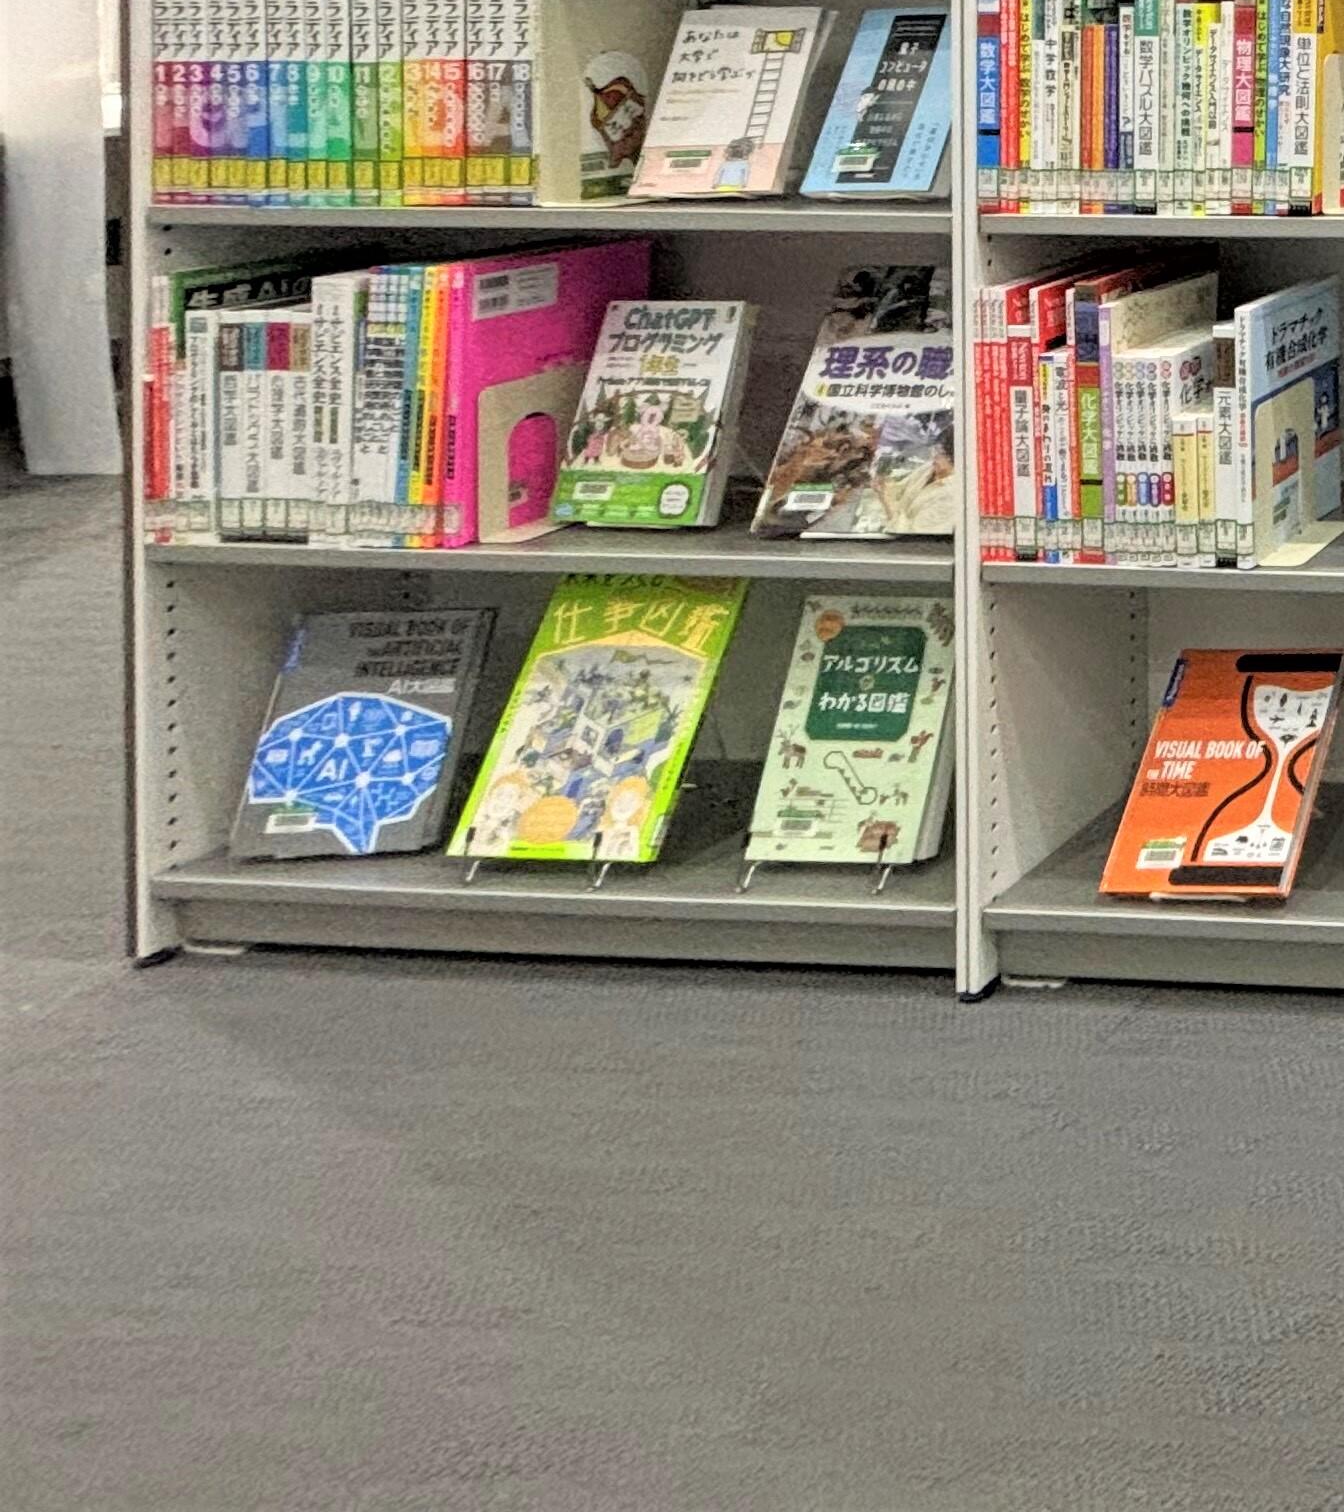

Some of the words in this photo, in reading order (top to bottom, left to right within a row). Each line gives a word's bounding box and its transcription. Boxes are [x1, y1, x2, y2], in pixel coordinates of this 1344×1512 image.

[684, 29, 740, 44] あなたは
[899, 42, 919, 55] 量子
[679, 49, 718, 63] 大学で
[879, 61, 927, 73] コンピュータ
[980, 43, 996, 125] 数学大図鑑
[1235, 40, 1253, 122] 物理大図鑑
[1139, 40, 1153, 155] 数学パズル大図鑑
[1295, 36, 1311, 155] 単位と法則大図鑑
[624, 307, 717, 331] ChatGPT
[1271, 308, 1324, 340] ドラマチック
[609, 332, 723, 355] プログラミング
[1264, 326, 1329, 371] 有機合成化学
[821, 346, 954, 380] 理系の職
[1014, 390, 1031, 478] 量子論大図鑑
[1081, 392, 1099, 475] 化学大図鑑
[1217, 391, 1233, 465] 元素大図鑑
[553, 598, 731, 654] 仕事図鑑
[822, 654, 919, 673] アルゴリズム
[819, 692, 911, 713] わかる図鑑
[1155, 741, 1202, 759] VISUAL
[1205, 741, 1243, 759] BOOK
[1246, 741, 1264, 759] OF
[317, 758, 347, 781] AI
[1160, 761, 1197, 780] TIME
